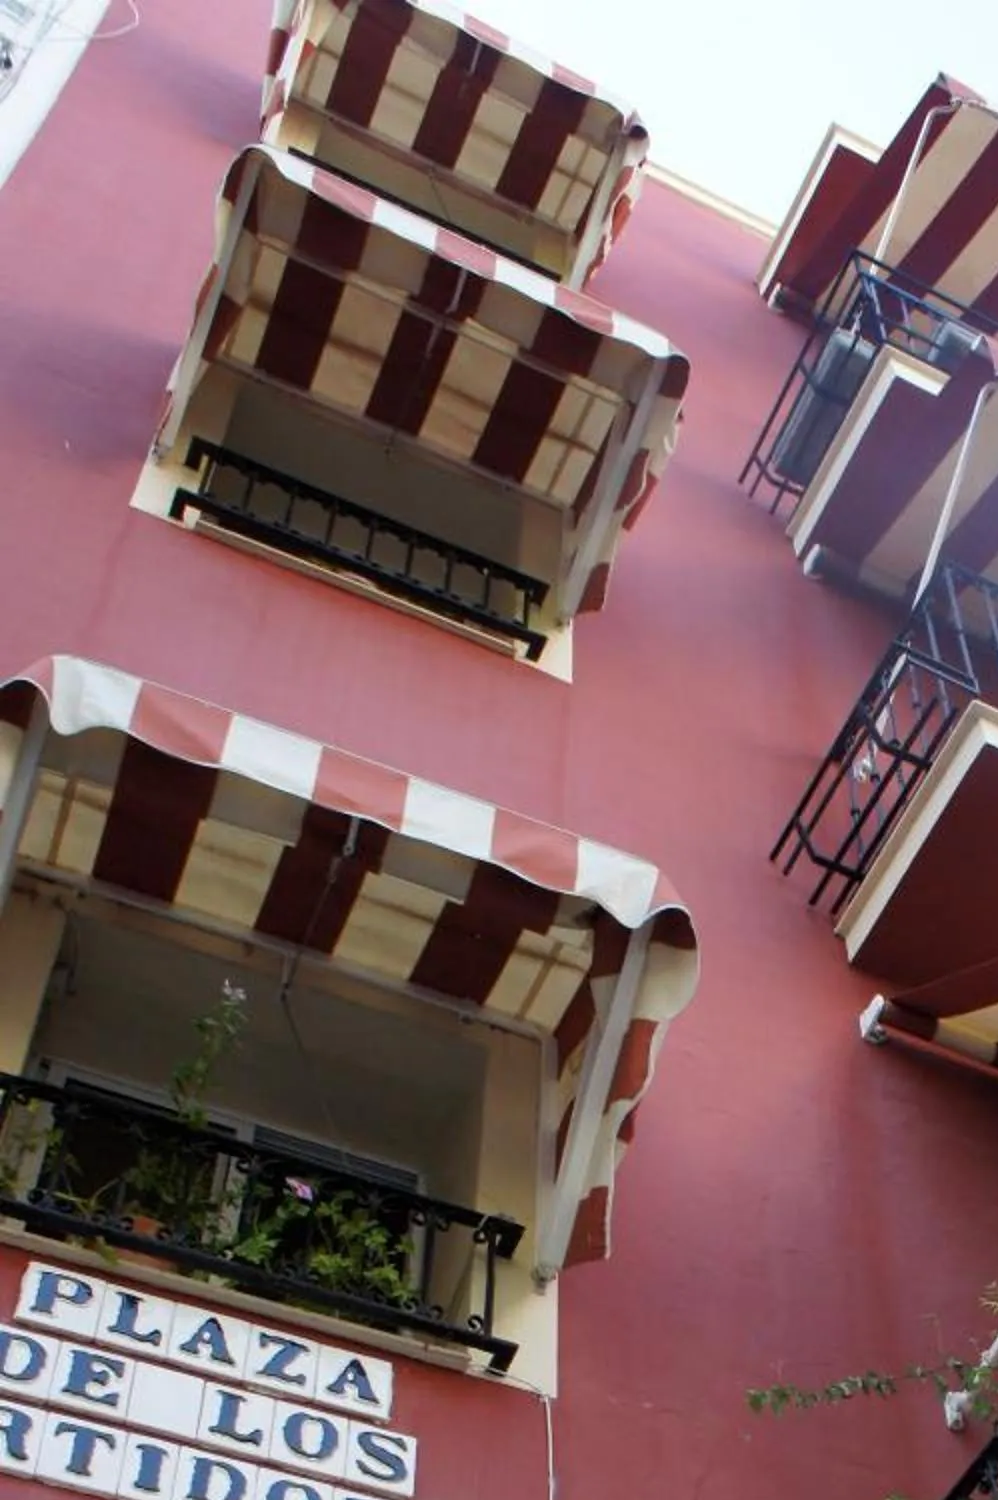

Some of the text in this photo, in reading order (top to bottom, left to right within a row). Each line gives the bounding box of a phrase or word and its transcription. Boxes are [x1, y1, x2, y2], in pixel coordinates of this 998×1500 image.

[0, 1331, 408, 1482] DE LOS
[34, 1270, 380, 1404] PLAZA
